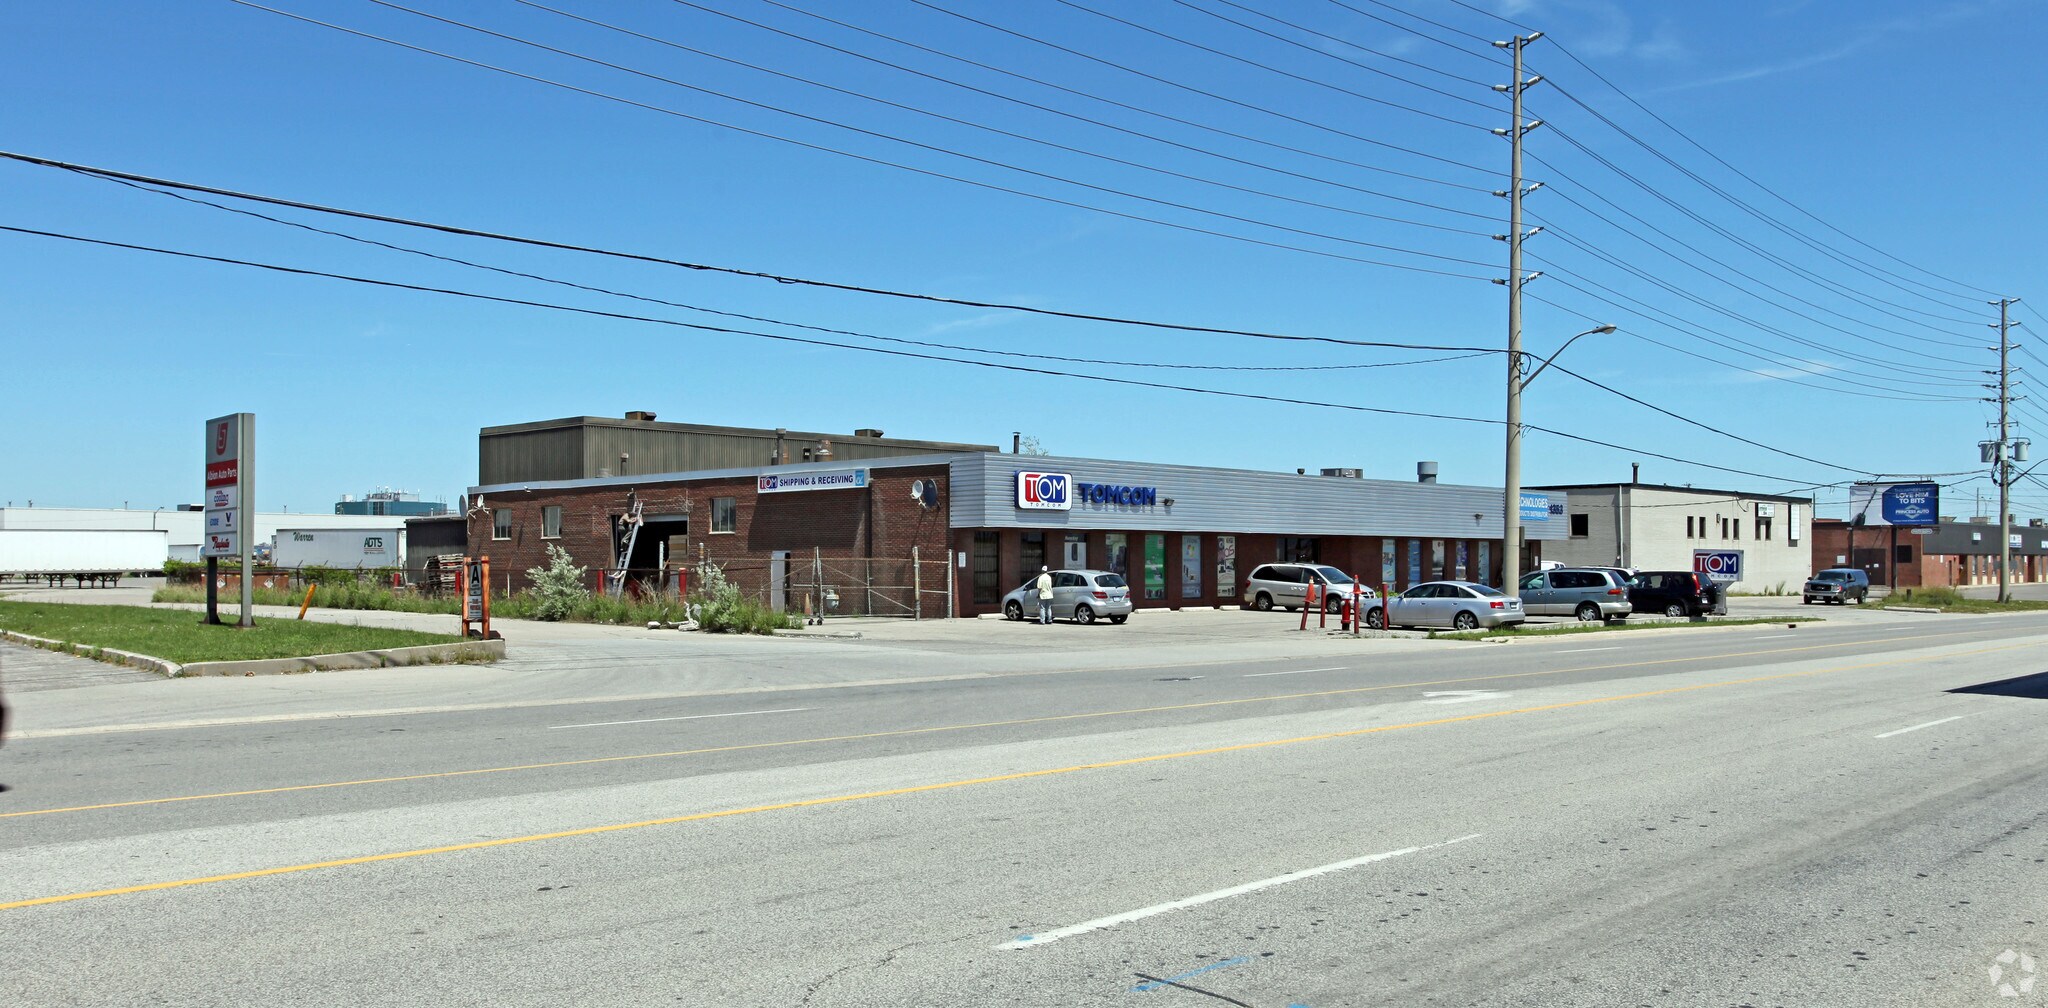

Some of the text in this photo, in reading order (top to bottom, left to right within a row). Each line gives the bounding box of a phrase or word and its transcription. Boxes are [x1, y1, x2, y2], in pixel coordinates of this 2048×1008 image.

[219, 470, 227, 478] Auto
[228, 468, 237, 477] Parts
[760, 475, 853, 489] TOM SHIPPING & RECEIVING
[1026, 477, 1065, 500] TOM
[1078, 483, 1157, 506] TOMCOM
[1519, 496, 1548, 508] CHNOLOGIES
[293, 531, 314, 542] Warren
[1695, 555, 1737, 572] TOM
